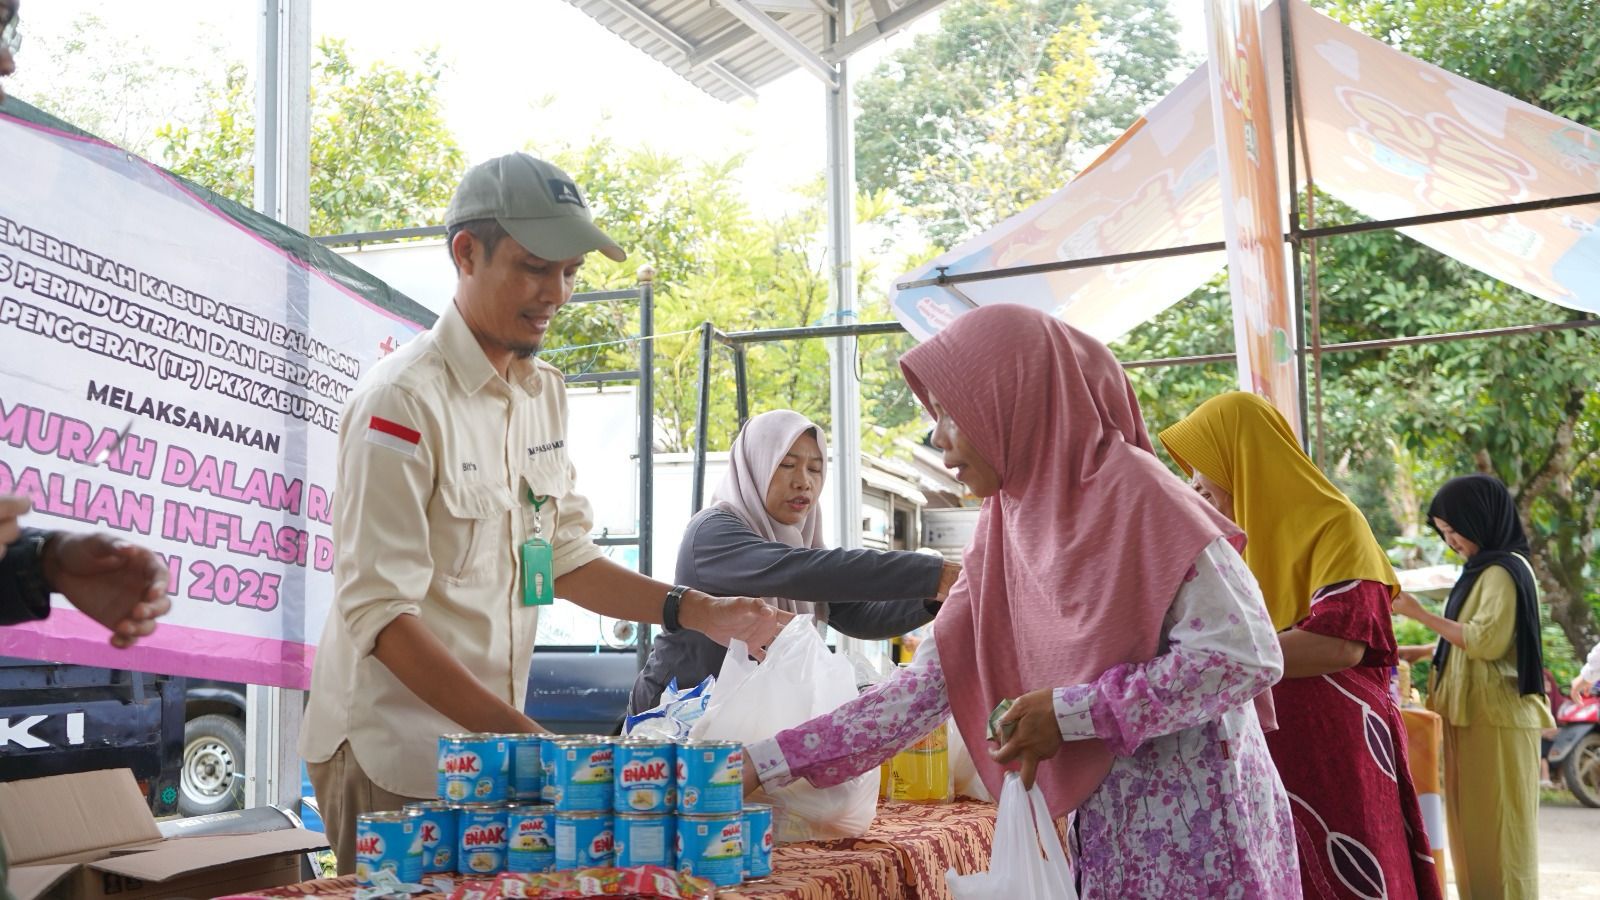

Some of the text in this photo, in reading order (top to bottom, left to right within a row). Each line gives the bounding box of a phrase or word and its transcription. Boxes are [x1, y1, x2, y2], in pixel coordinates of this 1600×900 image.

[0, 296, 157, 371] PENGGERAK
[158, 349, 204, 390] (TP)
[205, 366, 252, 402] PKK
[14, 261, 207, 352] PERINDUSTRIAN
[209, 333, 257, 370] DAN
[259, 350, 353, 404] PERDAGAN
[140, 272, 270, 341] KABUPATEN
[270, 322, 360, 380] BALANGAN
[86, 380, 281, 453] MELAKSANAKAN
[162, 445, 304, 516] DALAM
[162, 500, 309, 567] INFLASI
[188, 559, 282, 612] 2025
[623, 763, 668, 783] ENAAK
[465, 827, 507, 846] ENAAK
